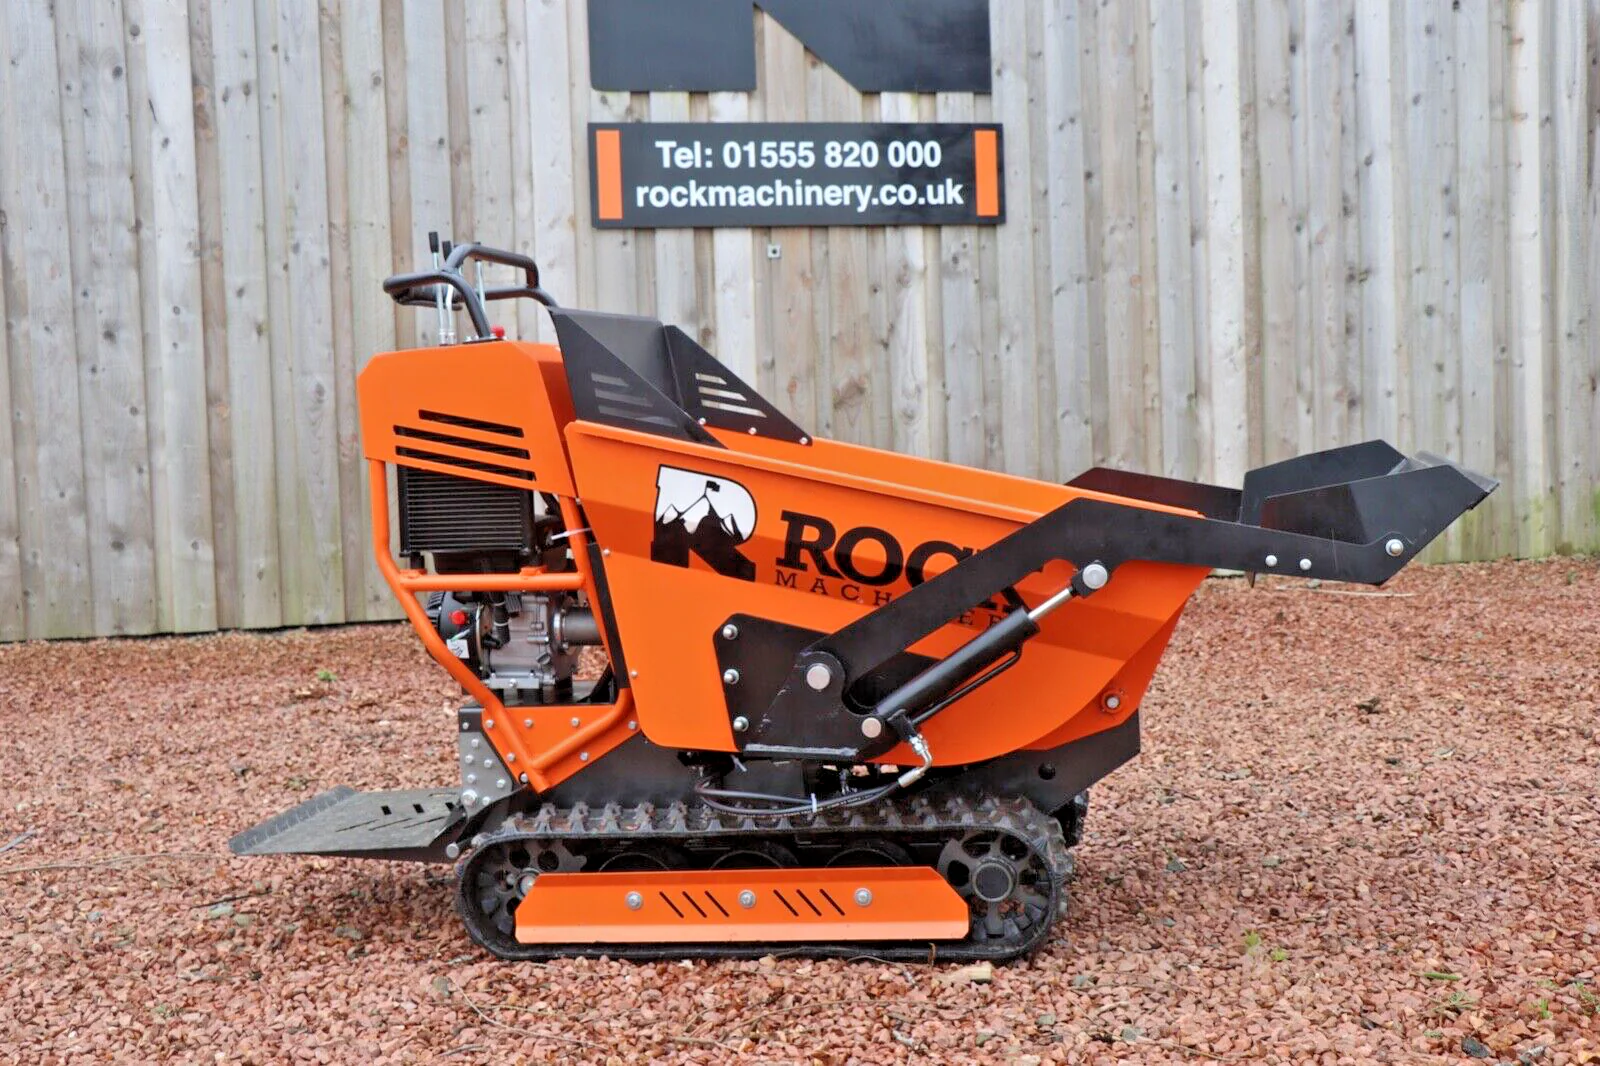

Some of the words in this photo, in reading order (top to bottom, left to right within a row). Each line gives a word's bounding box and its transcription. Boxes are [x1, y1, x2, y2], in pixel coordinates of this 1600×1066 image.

[655, 141, 713, 168] Tel:
[722, 141, 816, 168] 01555
[824, 141, 879, 168] 820
[887, 140, 942, 168] 000
[636, 177, 964, 213] rockmachinery.co.uk
